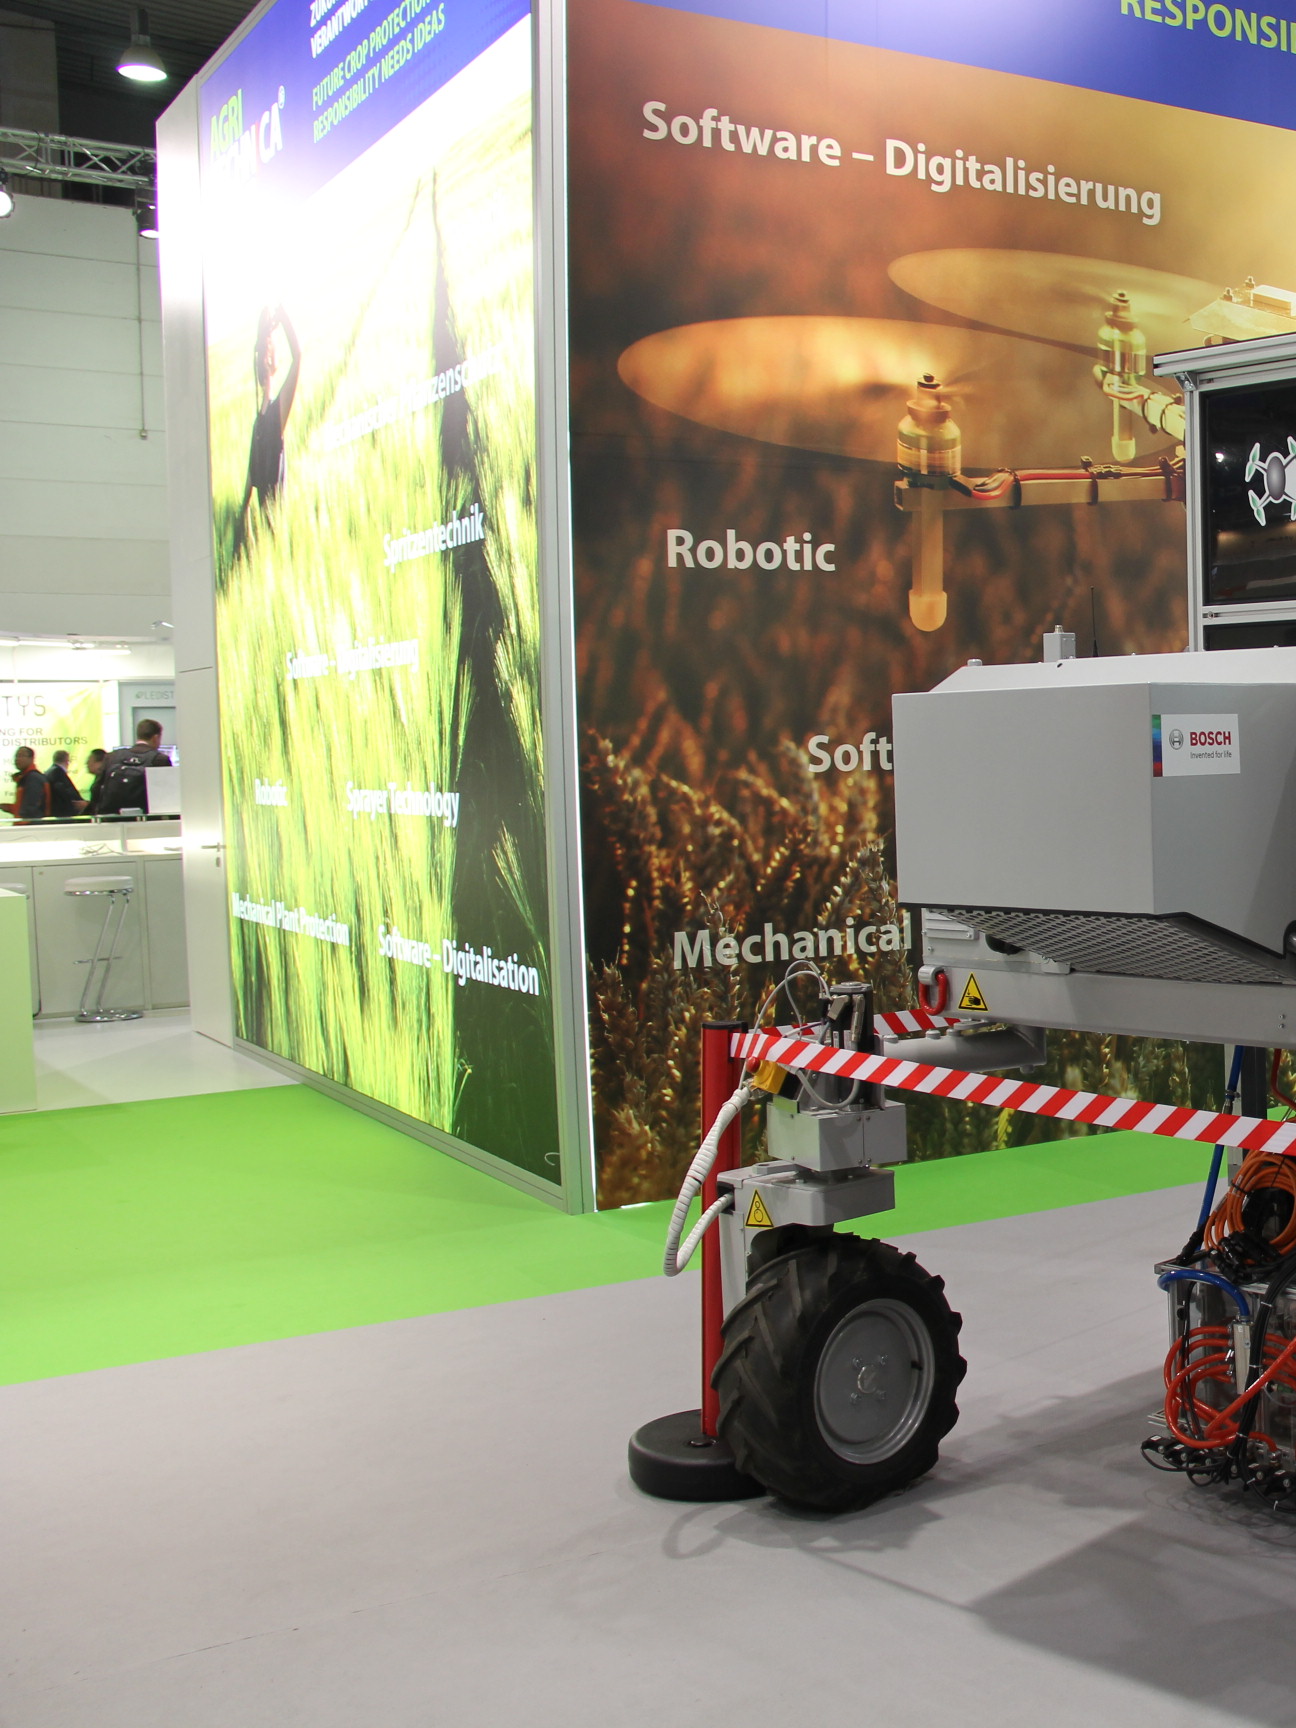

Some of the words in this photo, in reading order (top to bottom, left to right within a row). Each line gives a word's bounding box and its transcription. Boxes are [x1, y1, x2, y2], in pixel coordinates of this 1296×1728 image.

[313, 62, 380, 143] RESPONSIBILITY
[381, 33, 412, 82] NEEDS
[414, 3, 445, 53] IDEAS
[313, 62, 344, 111] FUTURE
[345, 39, 368, 79] CROP
[211, 88, 243, 160] AGRI
[642, 101, 841, 167] Software
[885, 138, 1161, 226] Digitalisierung
[667, 529, 836, 571] Robotic
[2, 696, 46, 717] TYS
[2, 736, 88, 747] DISTRIBUTORS
[19, 727, 44, 736] FOR
[808, 731, 892, 774] Soft
[1190, 731, 1231, 746] BOSCH
[1190, 751, 1214, 759] Invented
[1215, 750, 1223, 759] for
[1223, 750, 1232, 759] life
[347, 781, 388, 820] Sprayer
[388, 782, 460, 828] Technology
[232, 891, 276, 928] Mechanical
[276, 901, 300, 933] Plant
[300, 907, 350, 946] Protection
[673, 912, 912, 969] Mechanical
[378, 924, 431, 968] Software
[442, 938, 540, 996] Digitalisation
